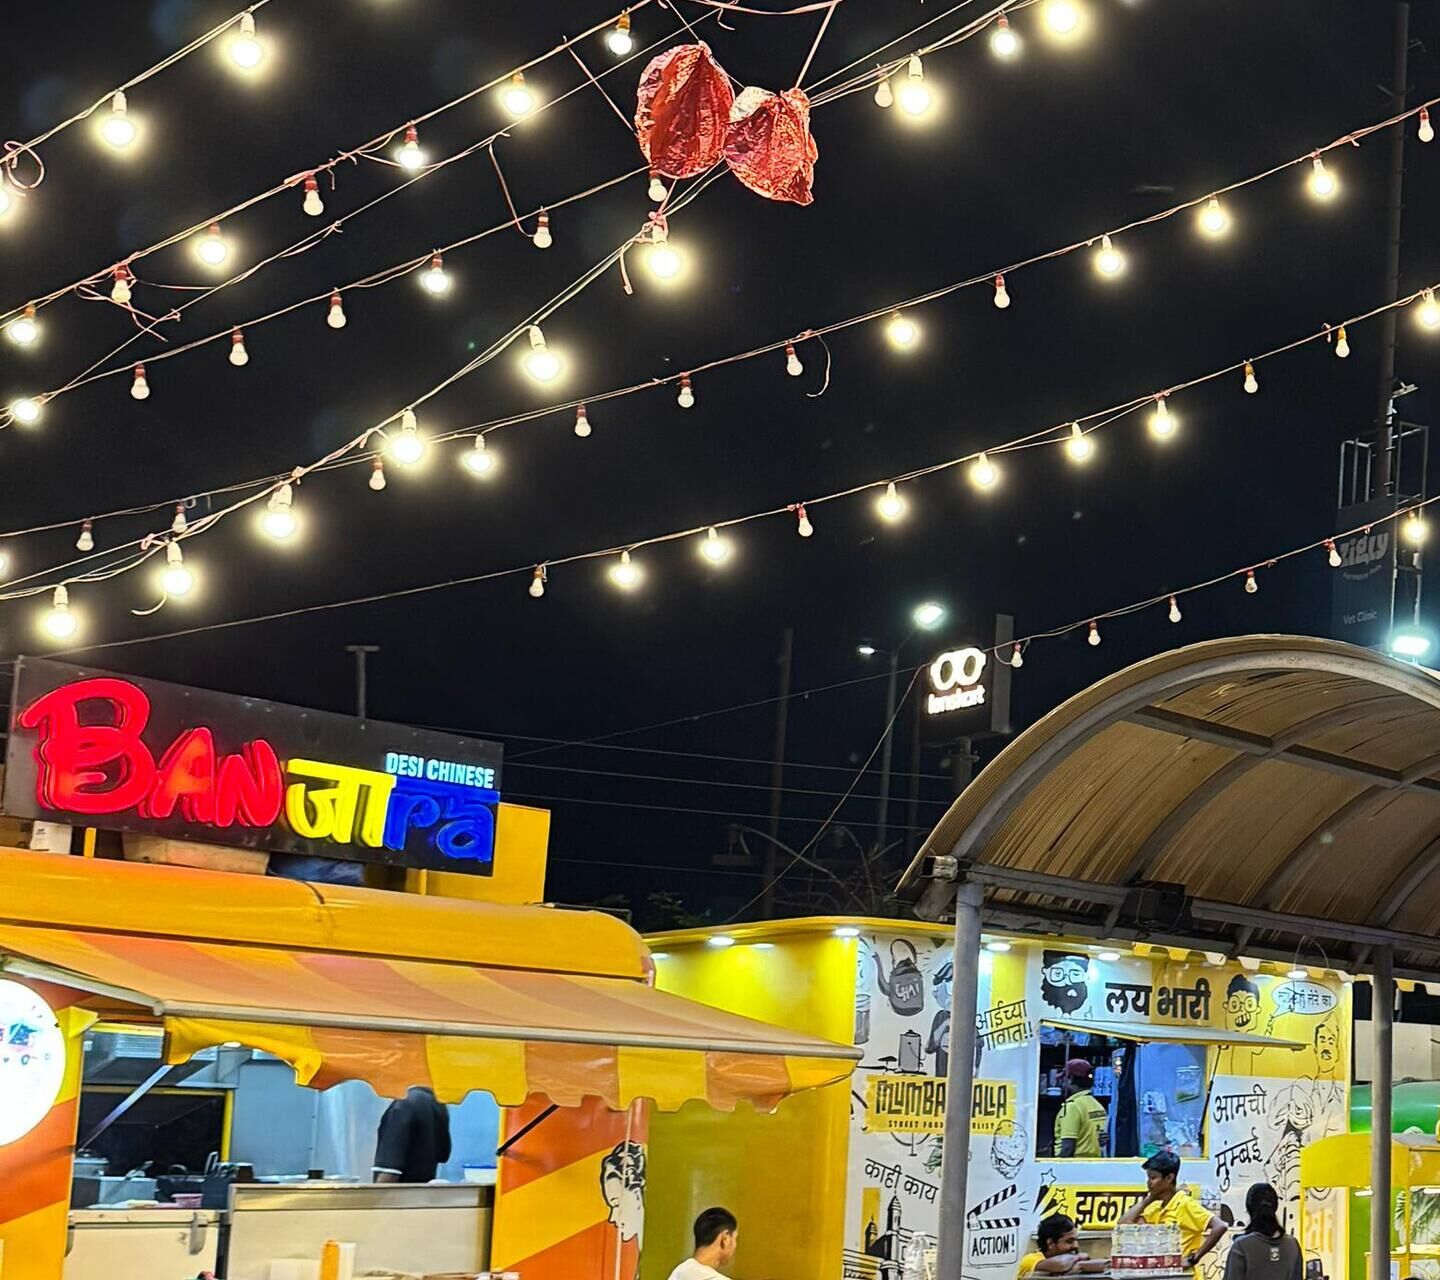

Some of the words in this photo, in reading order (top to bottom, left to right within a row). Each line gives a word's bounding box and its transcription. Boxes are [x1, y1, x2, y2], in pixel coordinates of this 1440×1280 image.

[385, 752, 425, 777] DESI
[426, 758, 495, 789] CHINESE
[1105, 982, 1152, 1016] लय
[1157, 977, 1211, 1020] भारी
[1213, 1084, 1266, 1123] आमची
[903, 1174, 940, 1204] काय
